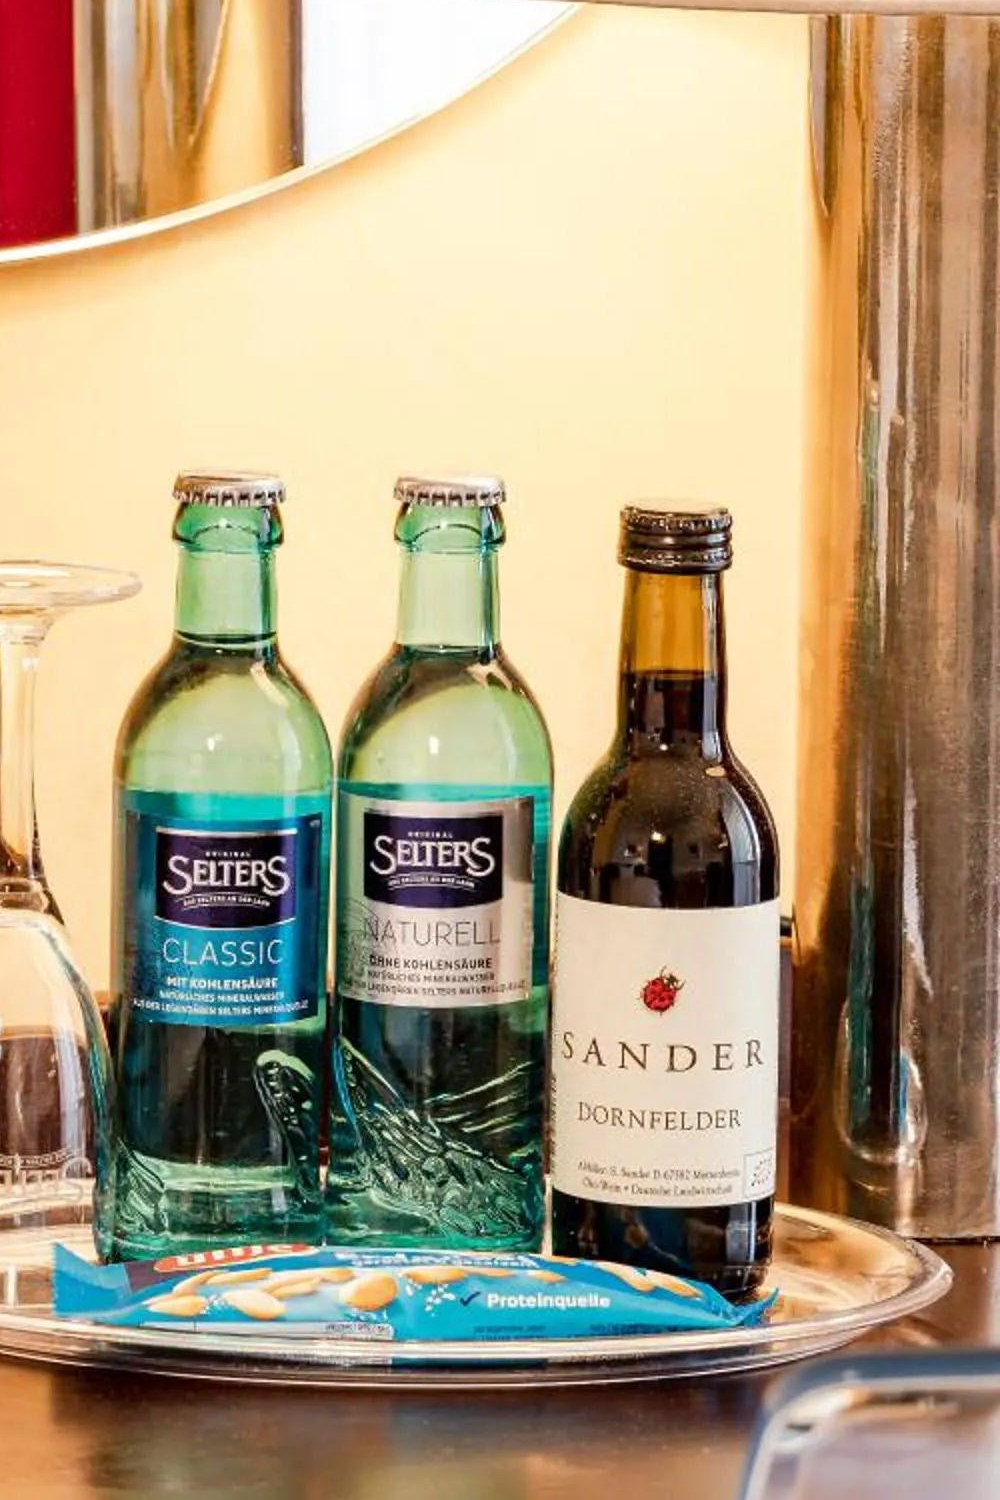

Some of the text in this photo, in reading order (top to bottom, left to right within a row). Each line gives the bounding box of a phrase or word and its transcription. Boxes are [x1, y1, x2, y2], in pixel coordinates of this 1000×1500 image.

[369, 835, 496, 877] SELTERS
[162, 855, 291, 897] SELTERS
[364, 918, 501, 947] NATURELL
[163, 938, 284, 966] CLASSIC
[369, 953, 493, 971] OHNE KOHLENSÄURE
[166, 975, 279, 990] MIT KOHLENSÄURE
[562, 1031, 765, 1073] SANDER
[578, 1101, 742, 1132] DORNFELDER
[487, 1293, 611, 1310] Proteinquelle
